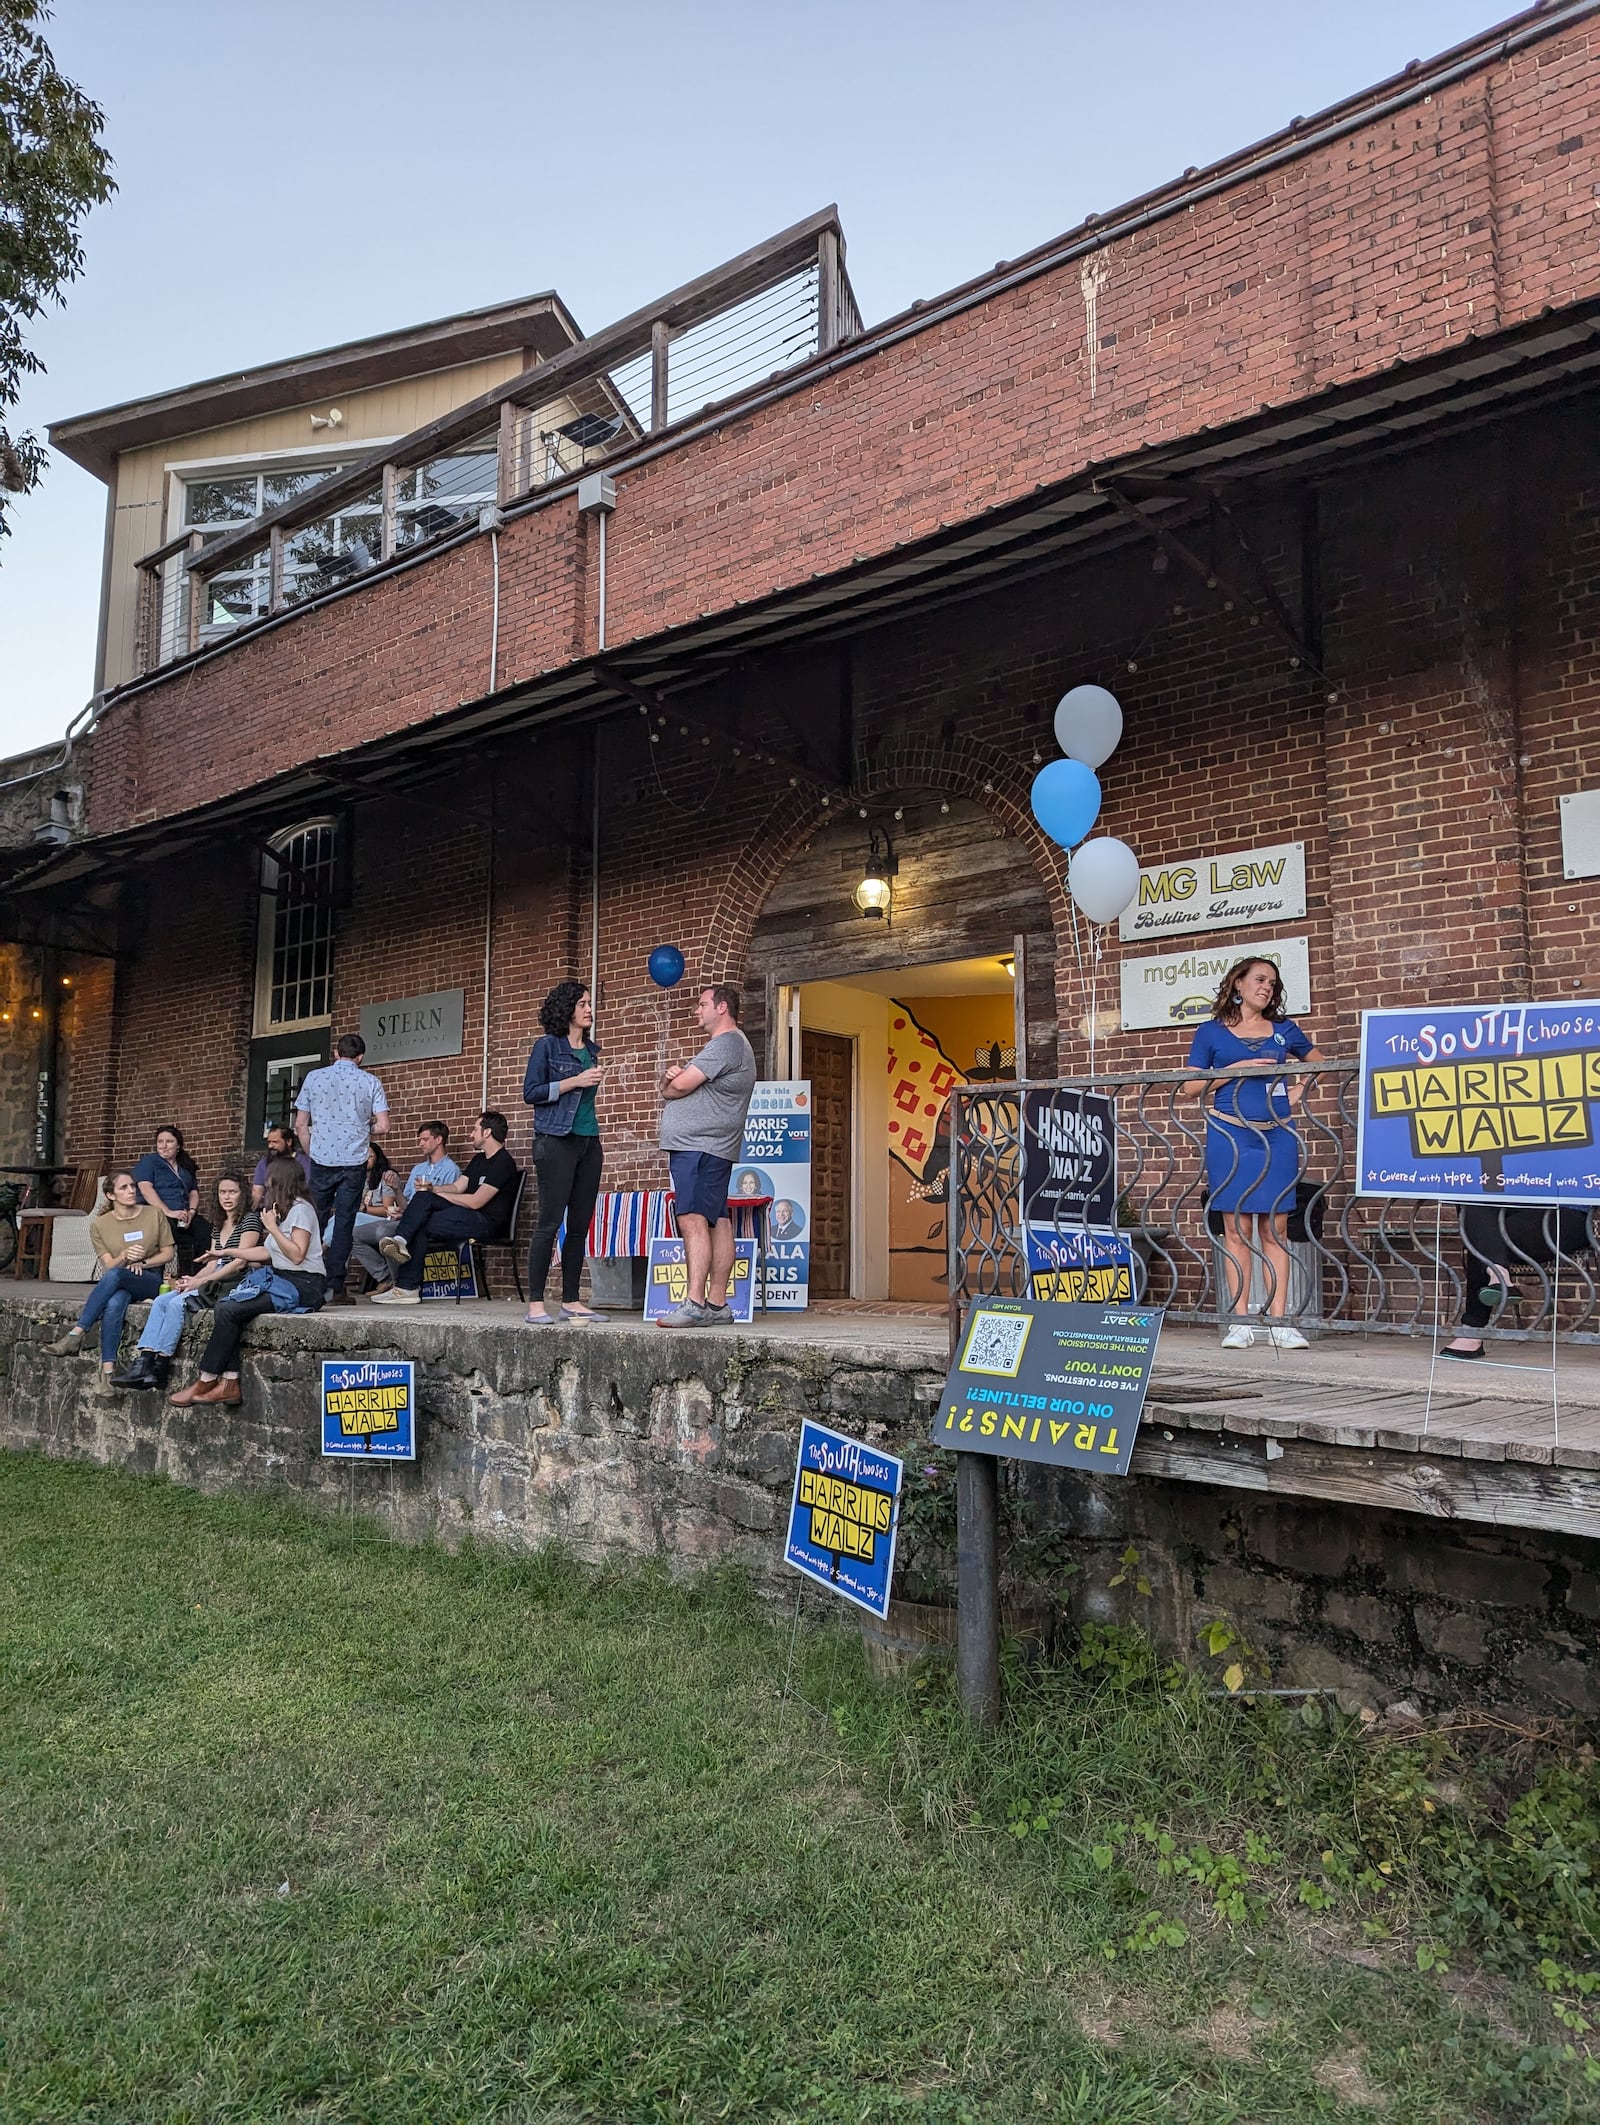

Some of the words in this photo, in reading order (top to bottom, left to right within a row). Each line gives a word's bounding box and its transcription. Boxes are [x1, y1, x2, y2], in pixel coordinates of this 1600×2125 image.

[1138, 867, 1197, 906] MG
[1210, 858, 1287, 894] Law
[1134, 910, 1200, 930] Beltline
[1206, 900, 1285, 919] Lawyers
[377, 1007, 443, 1037] STERN
[1386, 1035, 1419, 1054] The
[750, 1098, 793, 1110] ORGIA
[1038, 1106, 1103, 1157] HARRIS
[1420, 1105, 1584, 1149] WALZ
[743, 1130, 783, 1142] WALZ
[746, 1145, 783, 1157] 2024
[1380, 1170, 1417, 1183] Covered
[1419, 1173, 1441, 1183] with
[1444, 1171, 1473, 1186] Hope
[1496, 1173, 1552, 1188] Smothered
[1556, 1176, 1578, 1187] with
[1582, 1174, 1600, 1190] Jo
[425, 1252, 457, 1264] WAL
[1036, 1270, 1129, 1302] HARRIS
[1101, 1315, 1128, 1325] BAT
[1053, 1330, 1150, 1345] BETTERATLANTATRANSIT.COM
[1058, 1339, 1109, 1350] DISCUSSION!
[1109, 1343, 1126, 1352] THE
[1127, 1346, 1148, 1354] JOIN
[1065, 1361, 1097, 1374] YOU?
[1099, 1364, 1143, 1378] DON'T
[330, 1374, 342, 1384] The
[1043, 1373, 1097, 1387] QUESTIONS.
[1098, 1379, 1118, 1390] GOT
[1120, 1382, 1139, 1391] I'VE
[328, 1388, 406, 1410] HARRIS
[966, 1387, 1048, 1410] BELTLINE?!
[1050, 1399, 1085, 1415] OUR
[1087, 1403, 1114, 1419] ON
[343, 1412, 396, 1431] WALZ
[945, 1405, 1119, 1455] TRAINS?!
[809, 1444, 821, 1460] The
[802, 1476, 890, 1529] HARRIS
[814, 1515, 872, 1556] WALZ
